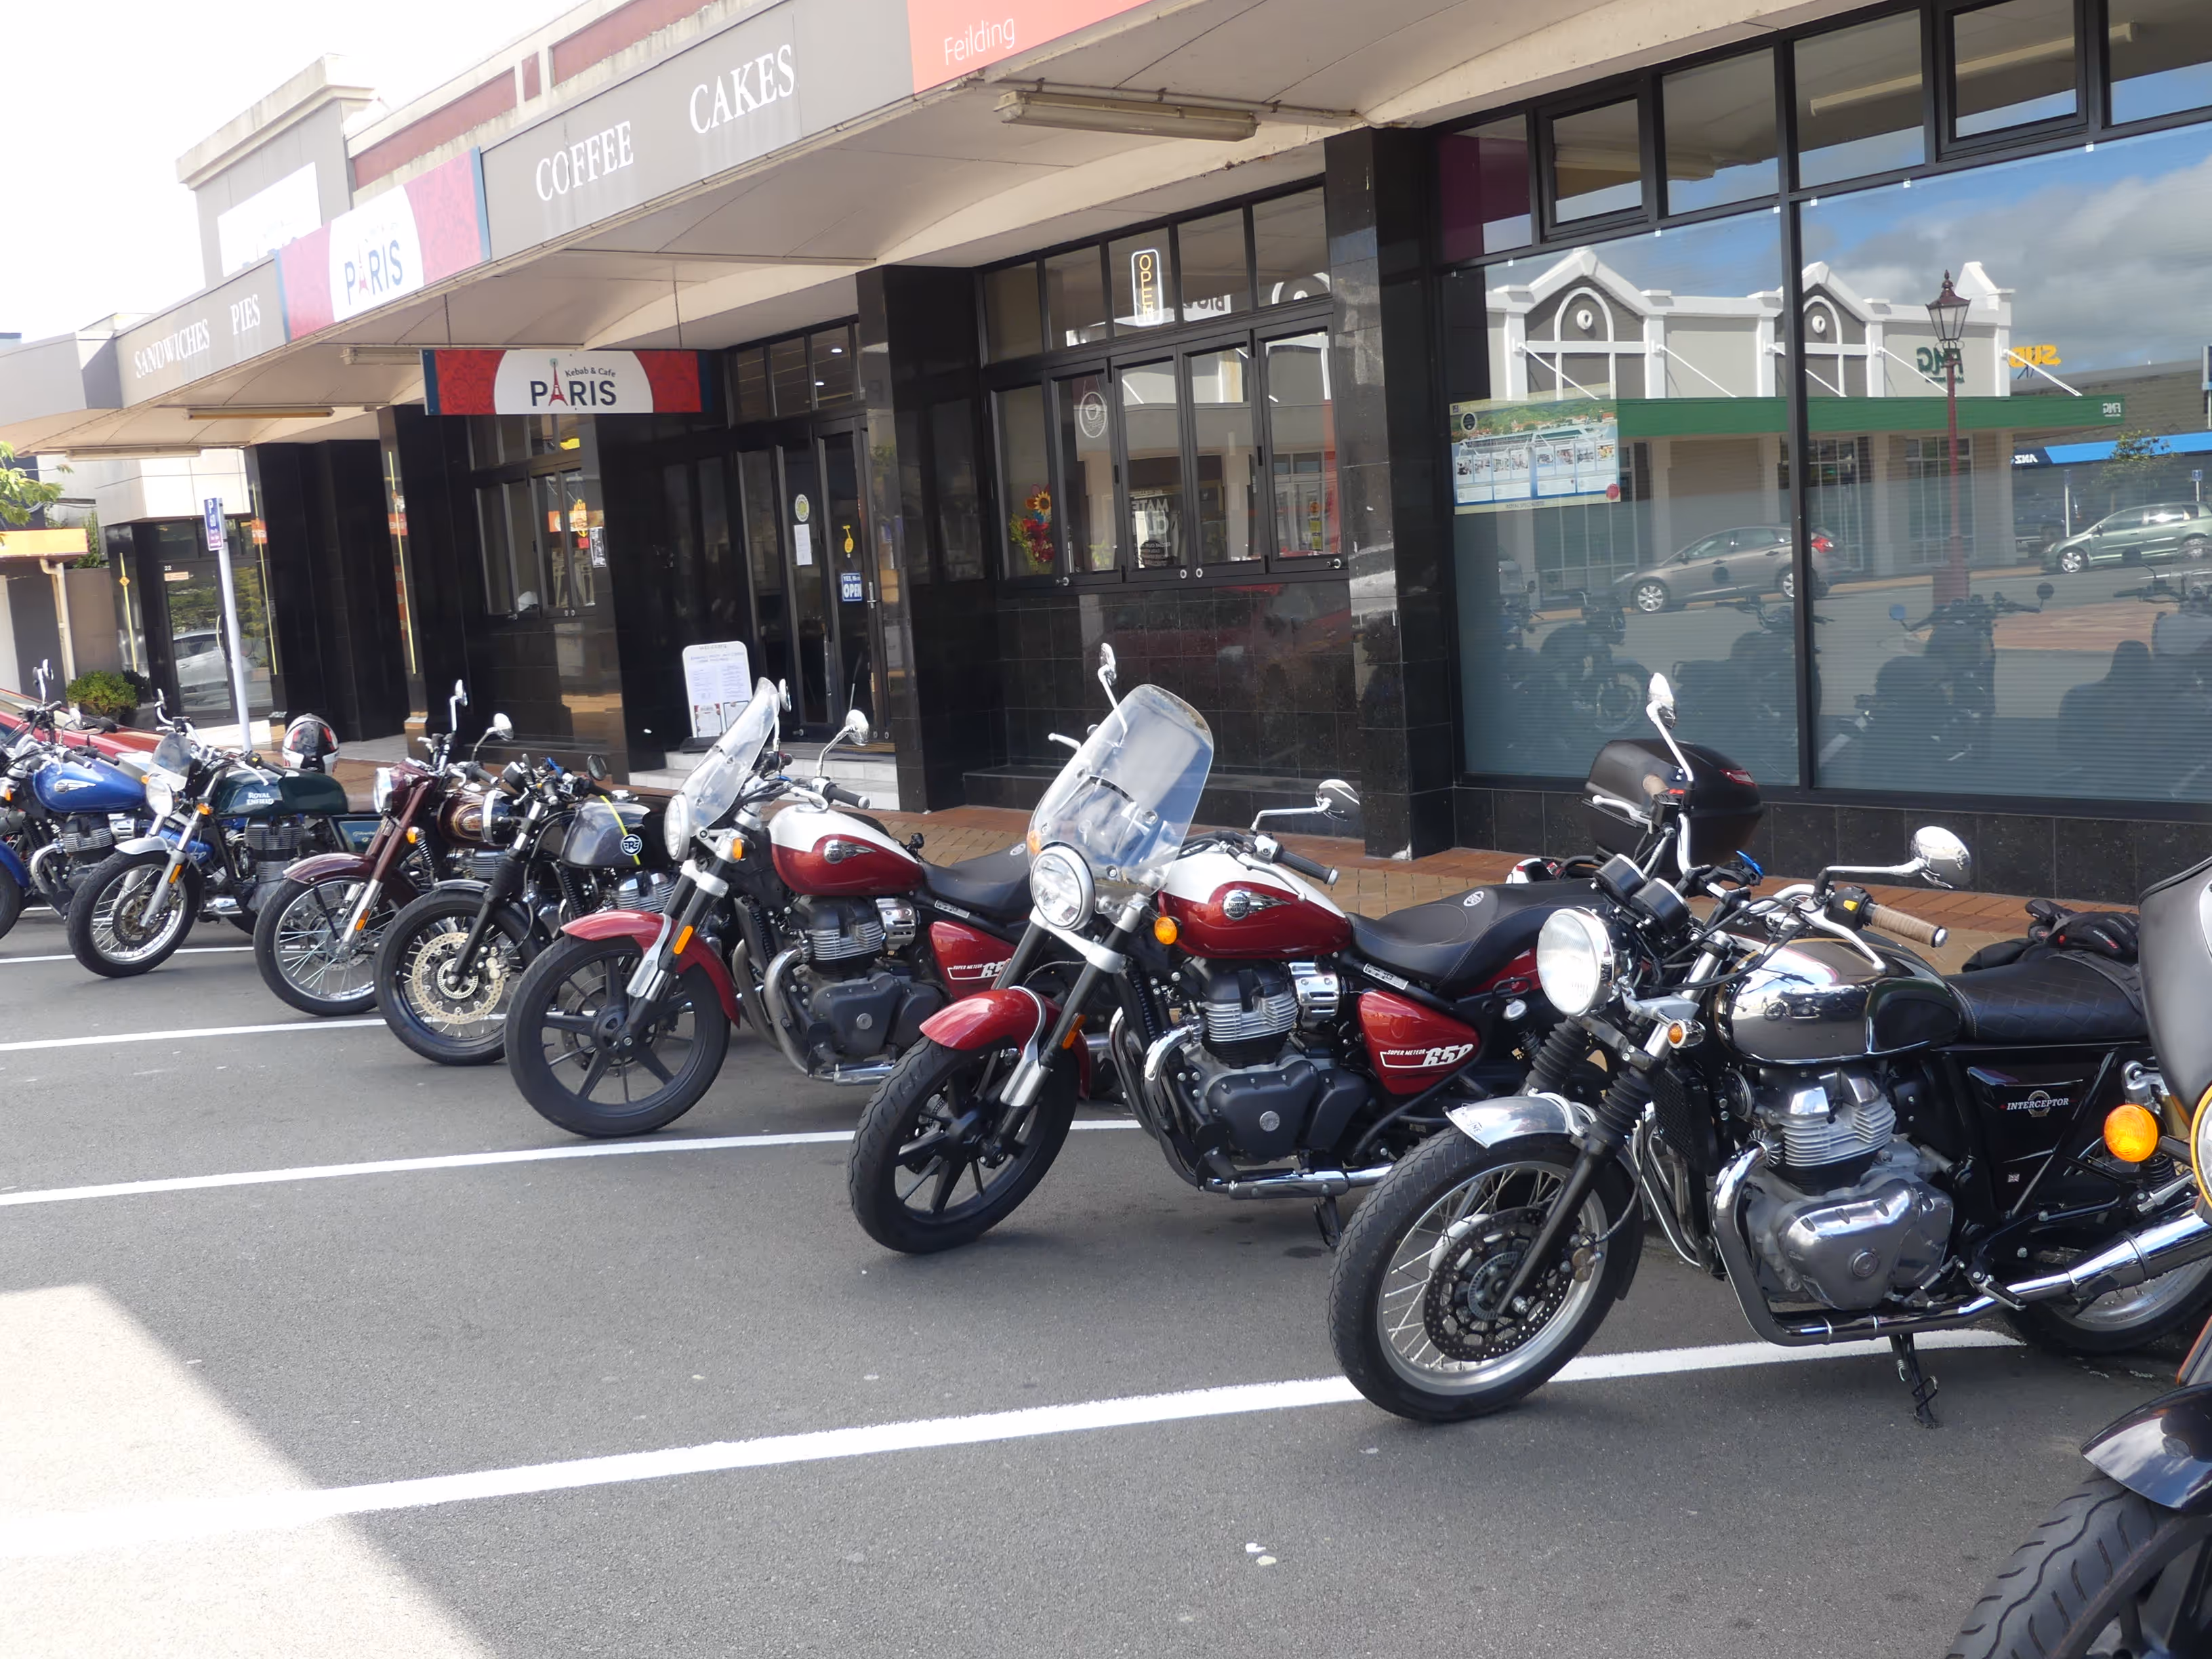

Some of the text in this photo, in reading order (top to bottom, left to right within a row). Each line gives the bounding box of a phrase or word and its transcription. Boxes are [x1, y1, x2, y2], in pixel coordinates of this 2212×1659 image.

[944, 18, 1015, 66] Feilding
[536, 44, 795, 201] COFFEE CAKES
[344, 239, 403, 306] PARIS
[1139, 254, 1155, 321] OPEN
[134, 293, 261, 379] SANDWICHES PIES
[565, 367, 589, 377] Kebab
[598, 367, 616, 377] Cafe
[530, 377, 617, 407] PARIS
[844, 583, 861, 598] OPEN
[1422, 1044, 1474, 1066] 650
[2006, 1098, 2069, 1111] INTERCEPTOR
